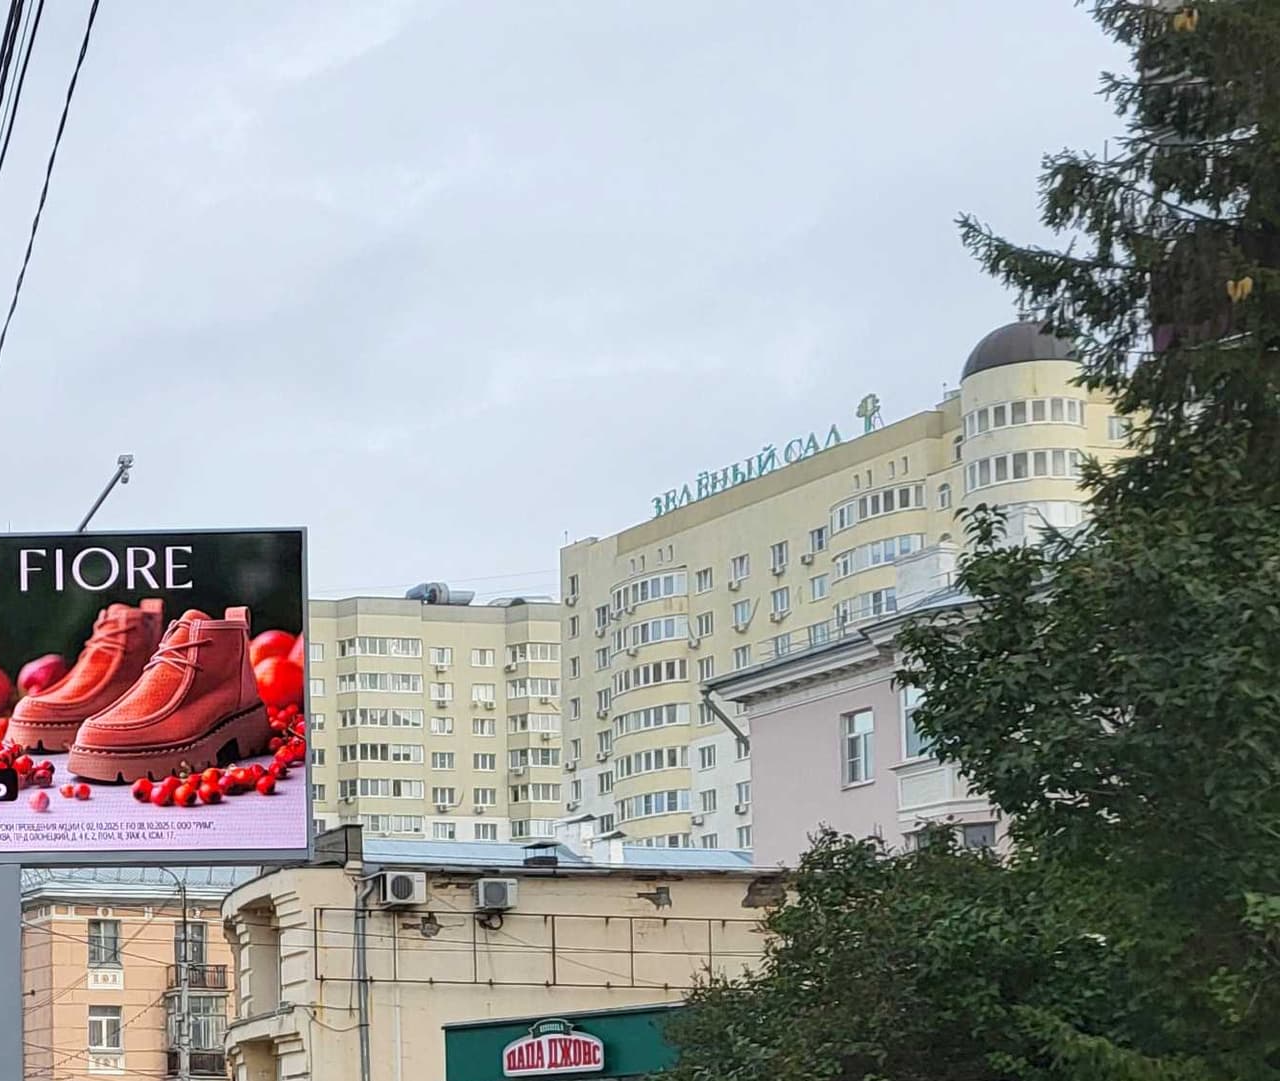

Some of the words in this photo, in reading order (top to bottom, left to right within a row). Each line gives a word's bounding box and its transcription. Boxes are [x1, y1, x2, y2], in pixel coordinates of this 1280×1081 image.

[20, 546, 193, 592] FIORE
[507, 1040, 545, 1071] ПАПА
[547, 1038, 601, 1069] ДЖОНС
